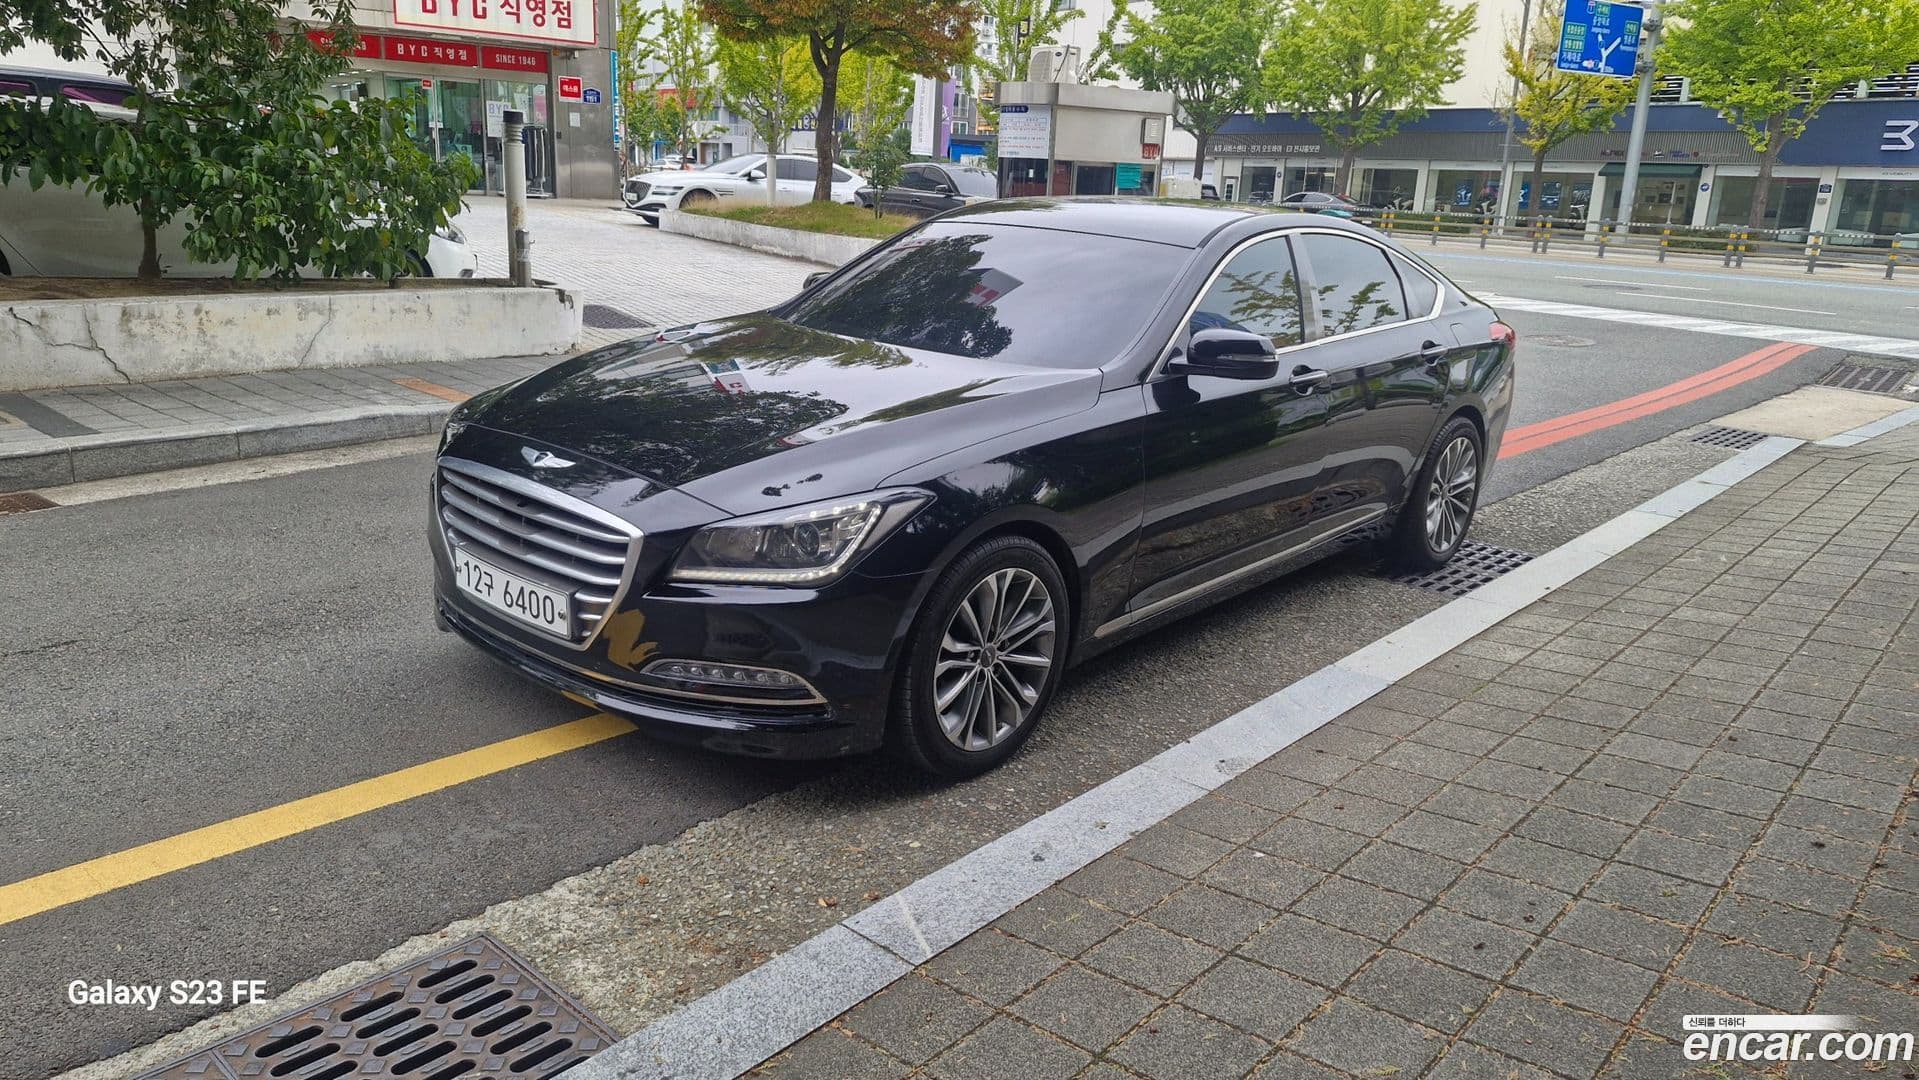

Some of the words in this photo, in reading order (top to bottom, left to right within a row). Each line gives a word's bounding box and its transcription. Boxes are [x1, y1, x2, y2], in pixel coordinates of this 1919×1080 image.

[500, 0, 572, 29] 직영점
[397, 43, 428, 57] BYC
[433, 47, 467, 61] 직영점
[495, 53, 516, 64] SINCE
[464, 559, 494, 597] 12구
[503, 580, 555, 625] 6400
